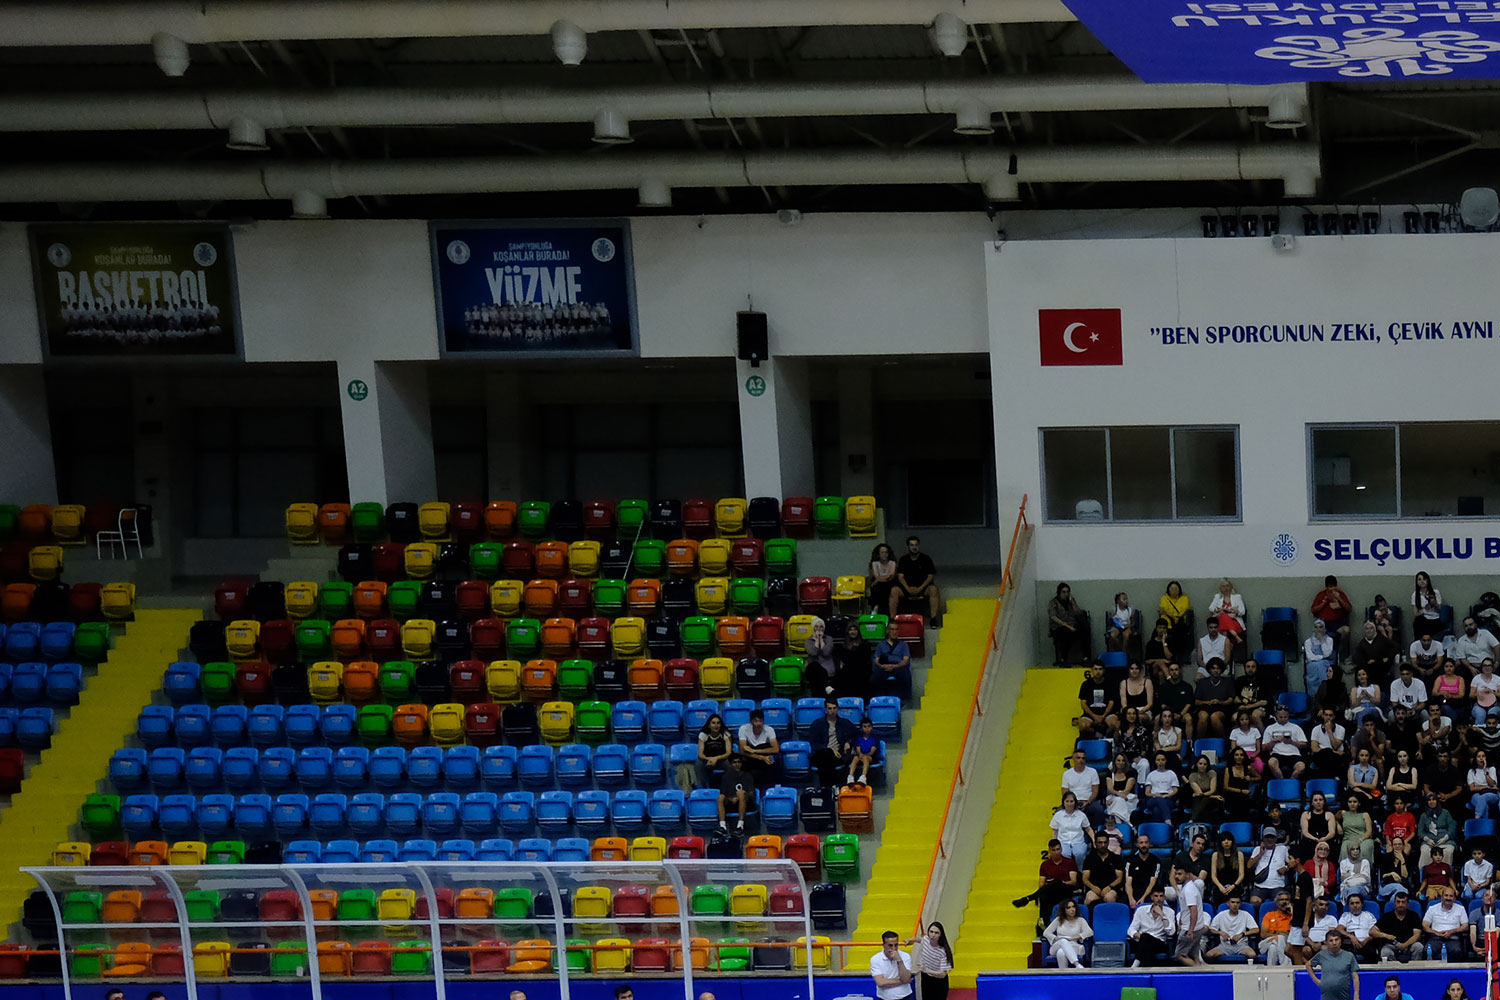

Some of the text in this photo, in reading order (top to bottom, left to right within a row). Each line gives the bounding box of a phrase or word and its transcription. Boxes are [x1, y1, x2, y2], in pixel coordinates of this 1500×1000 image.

[492, 251, 535, 263] KOŞANLAR
[484, 264, 583, 309] YÜZME
[1205, 324, 1325, 345] SPORCUNUN
[1450, 321, 1494, 341] AYNI
[351, 382, 366, 394] A2
[749, 378, 763, 390] A2
[1314, 537, 1474, 566] SELÇUKLU
[1041, 850, 1049, 860] 2
